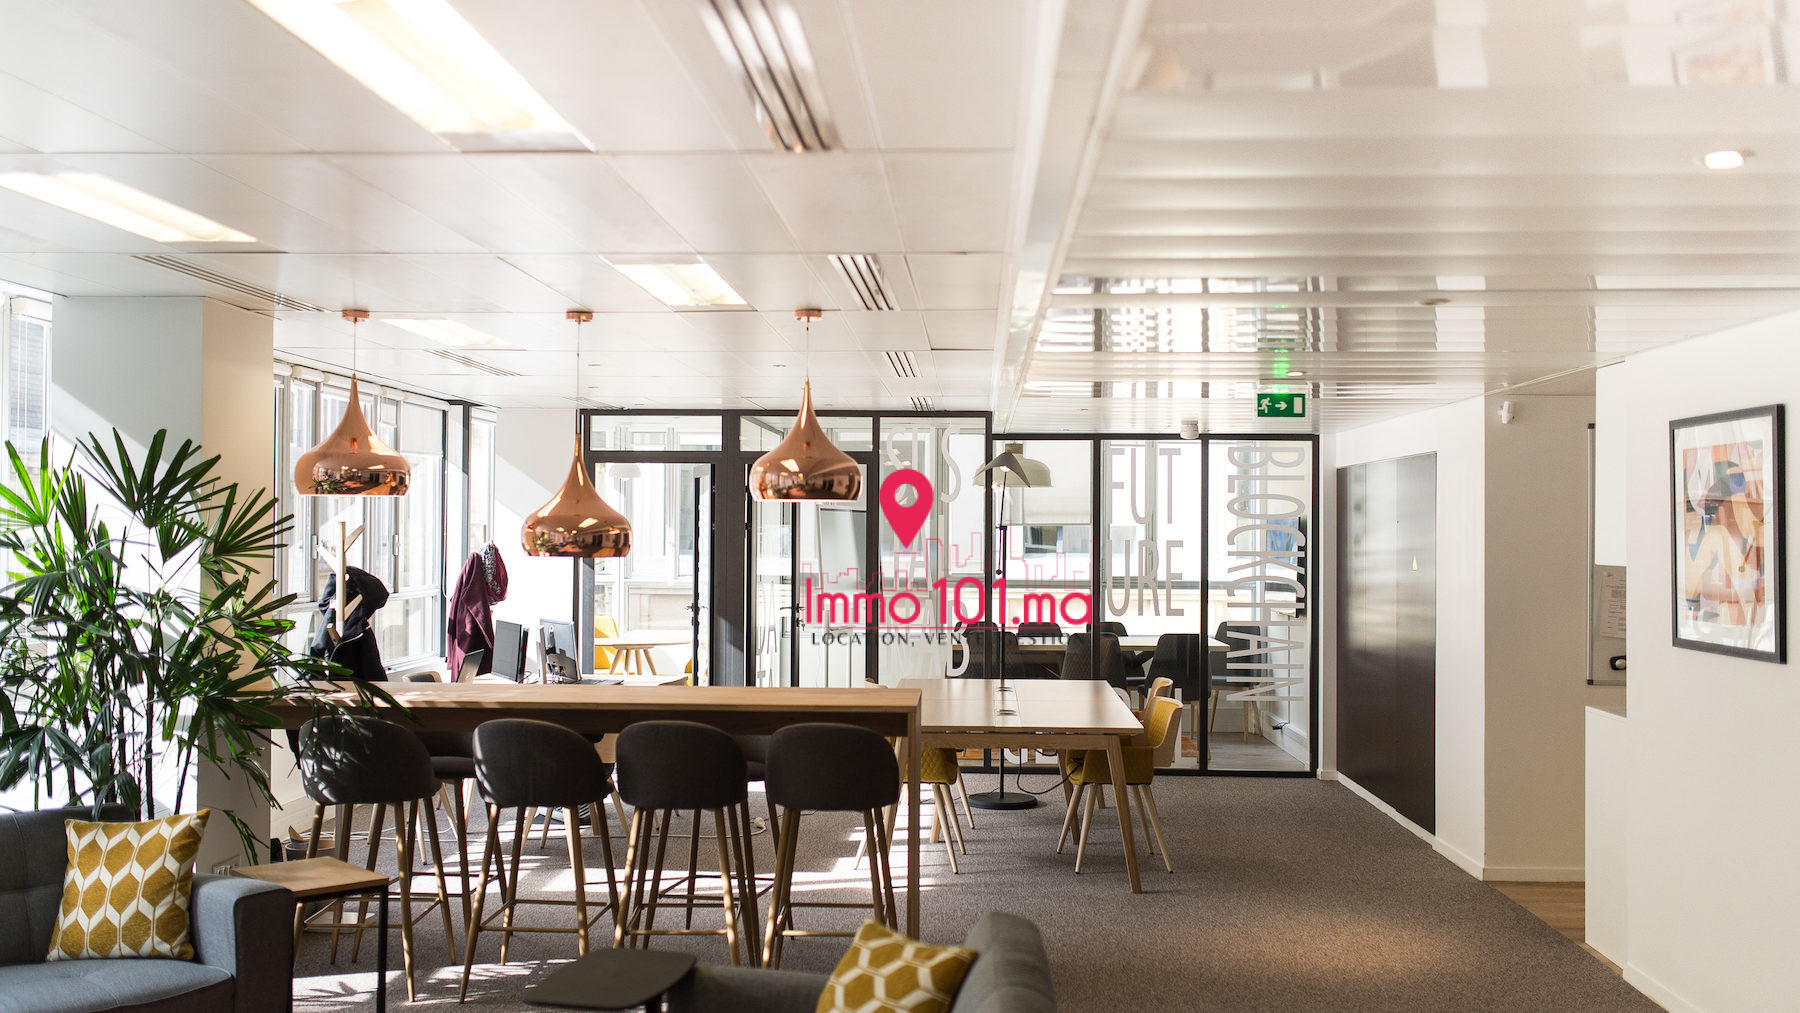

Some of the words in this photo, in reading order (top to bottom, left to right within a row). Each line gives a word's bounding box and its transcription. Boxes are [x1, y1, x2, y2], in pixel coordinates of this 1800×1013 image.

[1106, 448, 1181, 524] FUT
[1107, 540, 1184, 616] URE
[1227, 447, 1305, 700] BLOCKCHAIN
